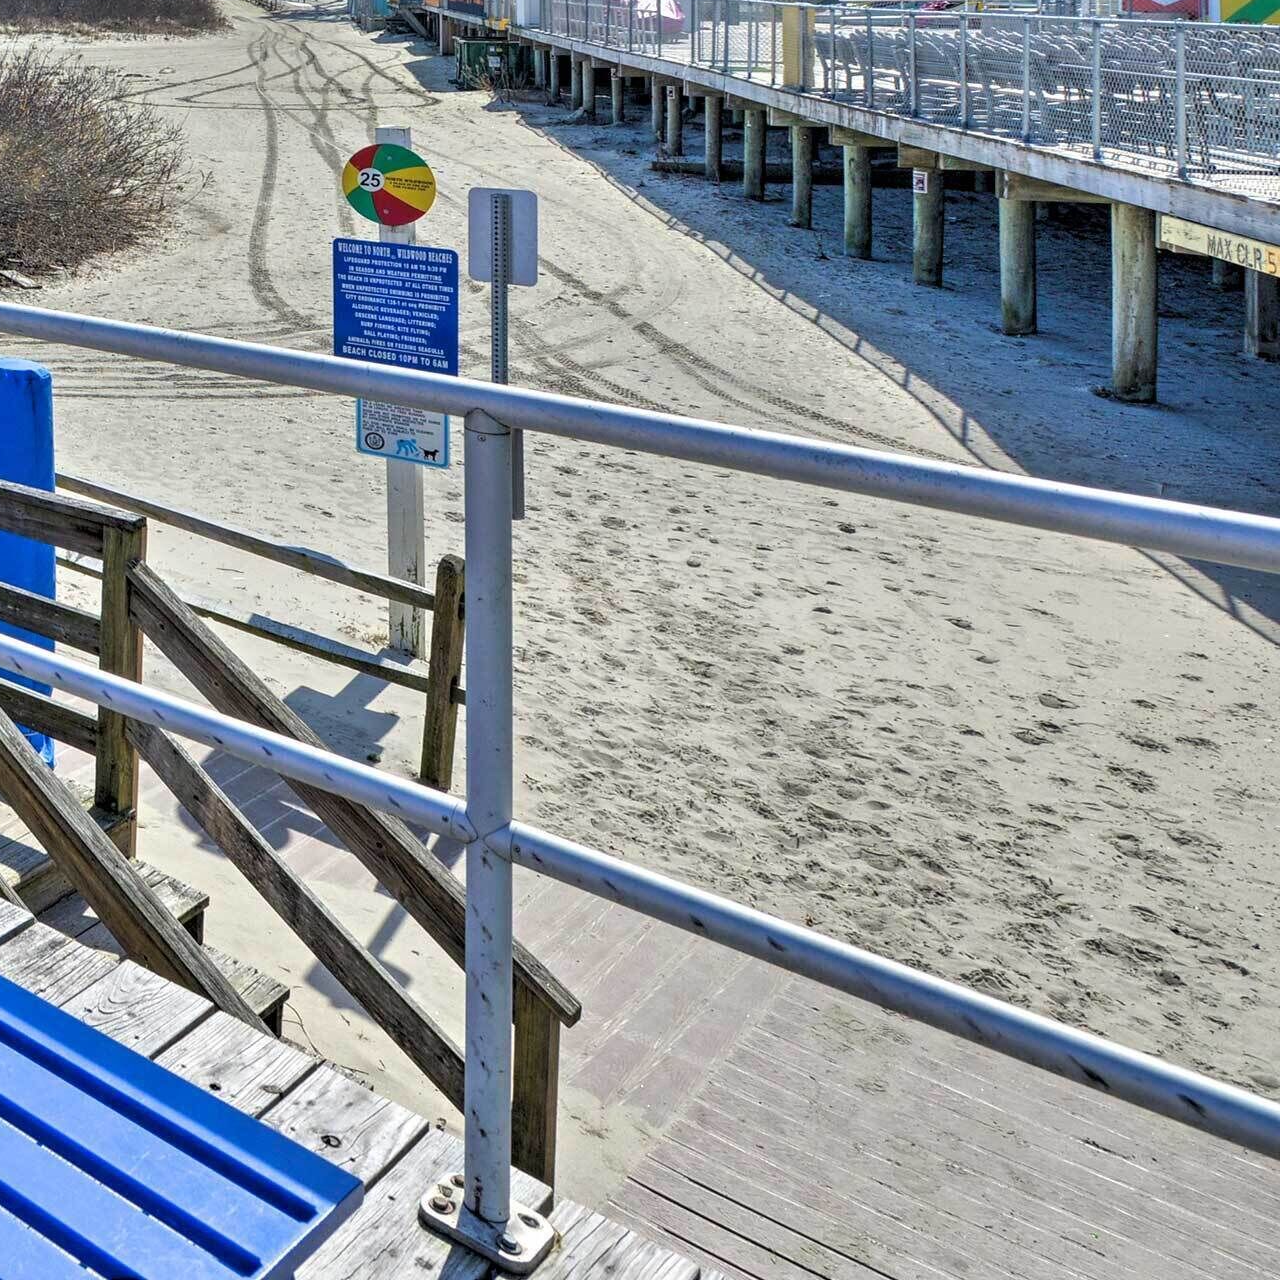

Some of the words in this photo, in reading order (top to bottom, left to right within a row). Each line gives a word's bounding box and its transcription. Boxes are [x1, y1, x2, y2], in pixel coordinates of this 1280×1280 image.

[360, 172, 380, 187] 25
[338, 242, 362, 255] WELCOME
[364, 244, 371, 255] TO
[397, 248, 426, 261] WILDWOOD
[428, 252, 453, 264] BEACHES
[1207, 234, 1233, 261] MAX
[1236, 243, 1262, 271] CLR
[371, 259, 402, 269] PROTECTION
[342, 345, 366, 357] BEACH
[368, 349, 397, 361] CLOSED
[399, 353, 418, 365] 10PM
[420, 357, 430, 366] TO
[432, 358, 449, 369] 6AM
